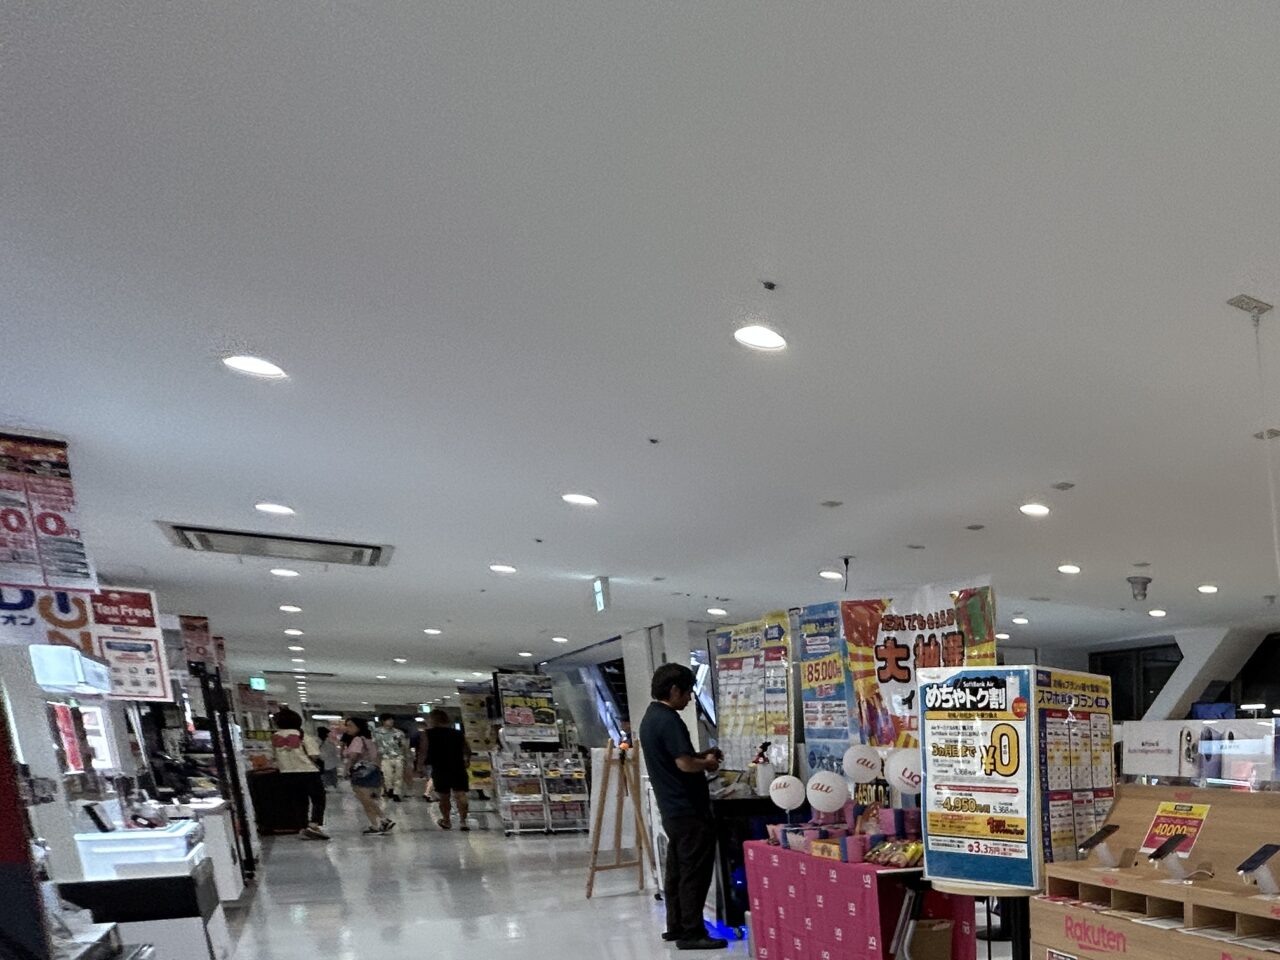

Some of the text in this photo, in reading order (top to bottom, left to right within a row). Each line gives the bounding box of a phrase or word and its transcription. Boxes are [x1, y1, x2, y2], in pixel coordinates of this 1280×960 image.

[121, 604, 151, 617] Free
[926, 684, 1005, 709] めちゃトク割
[856, 758, 876, 769] au
[902, 768, 921, 784] UQ
[811, 783, 833, 793] au
[1064, 915, 1127, 952] Rakuten
